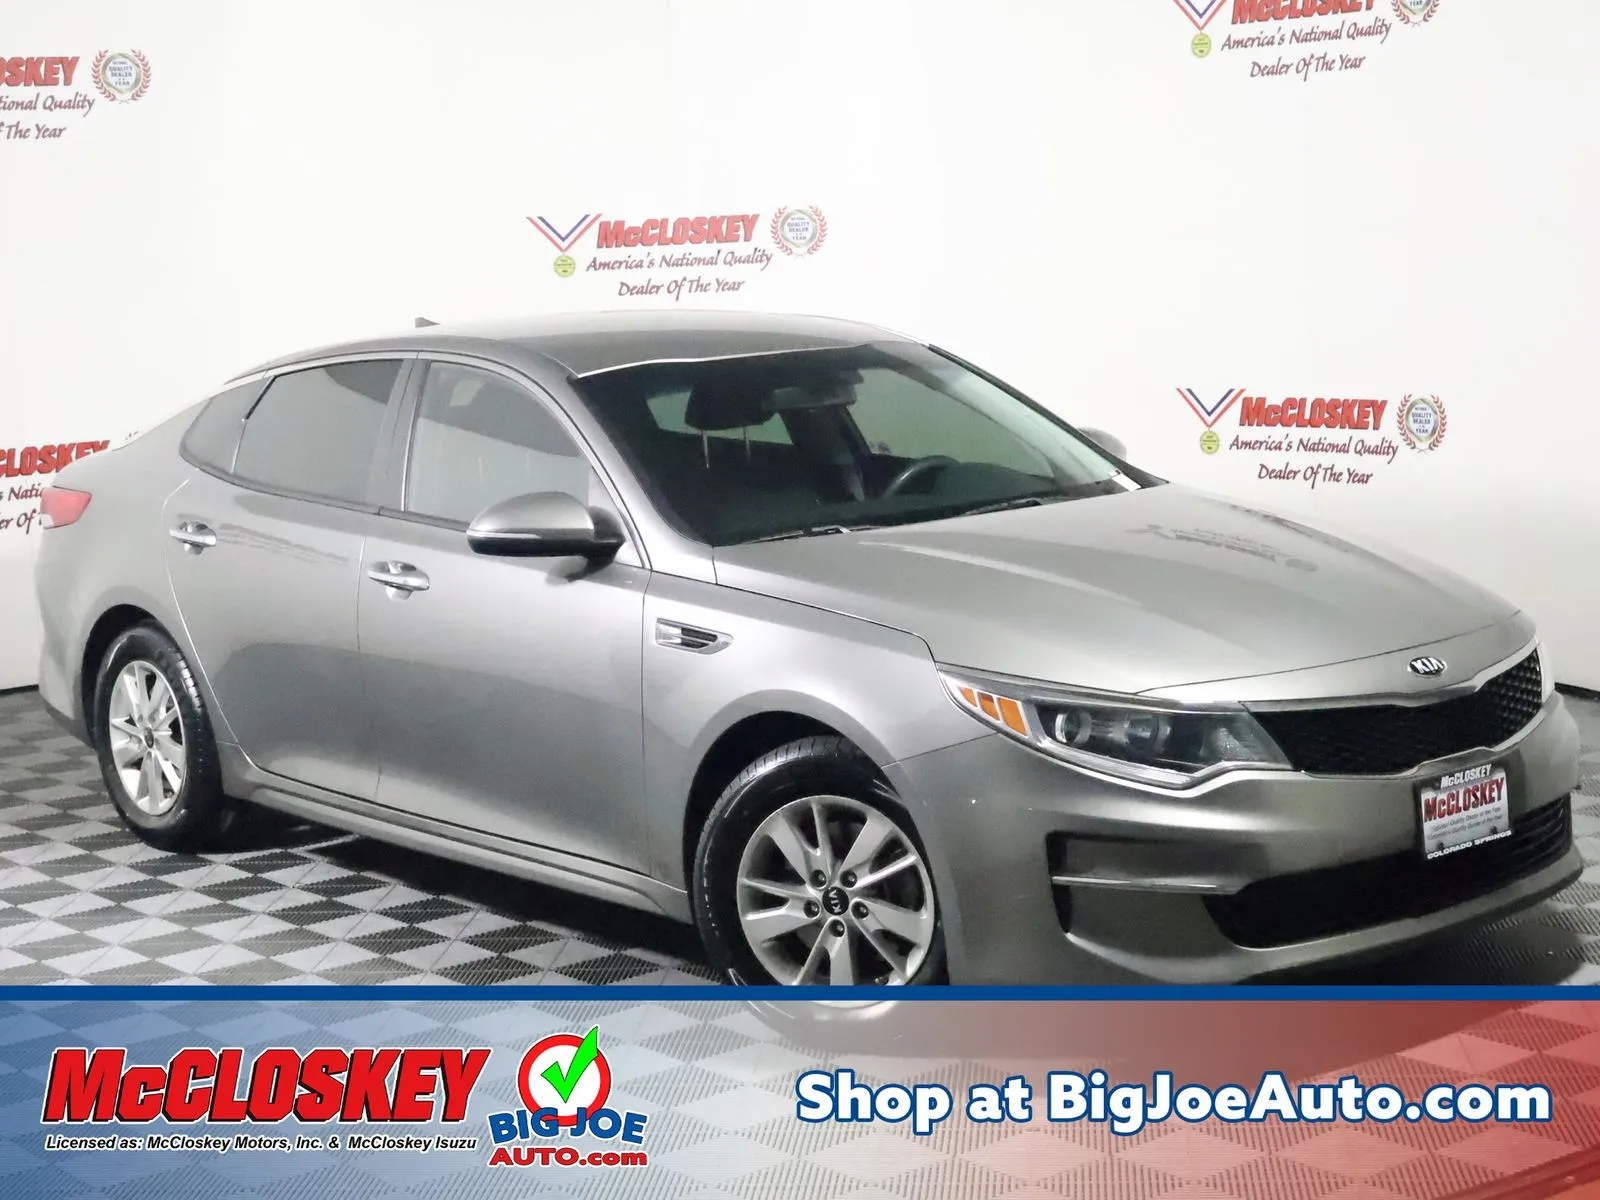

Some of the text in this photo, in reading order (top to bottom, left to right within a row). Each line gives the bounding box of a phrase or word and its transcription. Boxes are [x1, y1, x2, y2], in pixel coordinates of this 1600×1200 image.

[1221, 26, 1285, 51] America's
[1289, 20, 1345, 45] National
[1346, 16, 1392, 44] Quality
[1250, 51, 1366, 82] Dealer Of The Year
[42, 92, 95, 118] Quality
[5, 121, 31, 139] The
[35, 123, 67, 139] Year
[596, 214, 760, 248] McCLOSKEY
[586, 252, 655, 272] America's
[659, 249, 720, 269] National
[722, 247, 773, 271] Quality
[618, 276, 746, 301] Dealer Of The Year
[1239, 397, 1388, 430] McCLOSKEY
[1229, 434, 1292, 451] America's
[1296, 436, 1351, 454] National
[1354, 437, 1399, 464] Quality
[1257, 463, 1373, 489] Dealer Of The Year
[16, 508, 37, 535] Of
[1411, 657, 1443, 674] KIA
[1441, 764, 1492, 788] McCLOSKEY
[1423, 777, 1505, 822] McCLOSKEY
[1427, 830, 1512, 859] COLORADO SPRINGS
